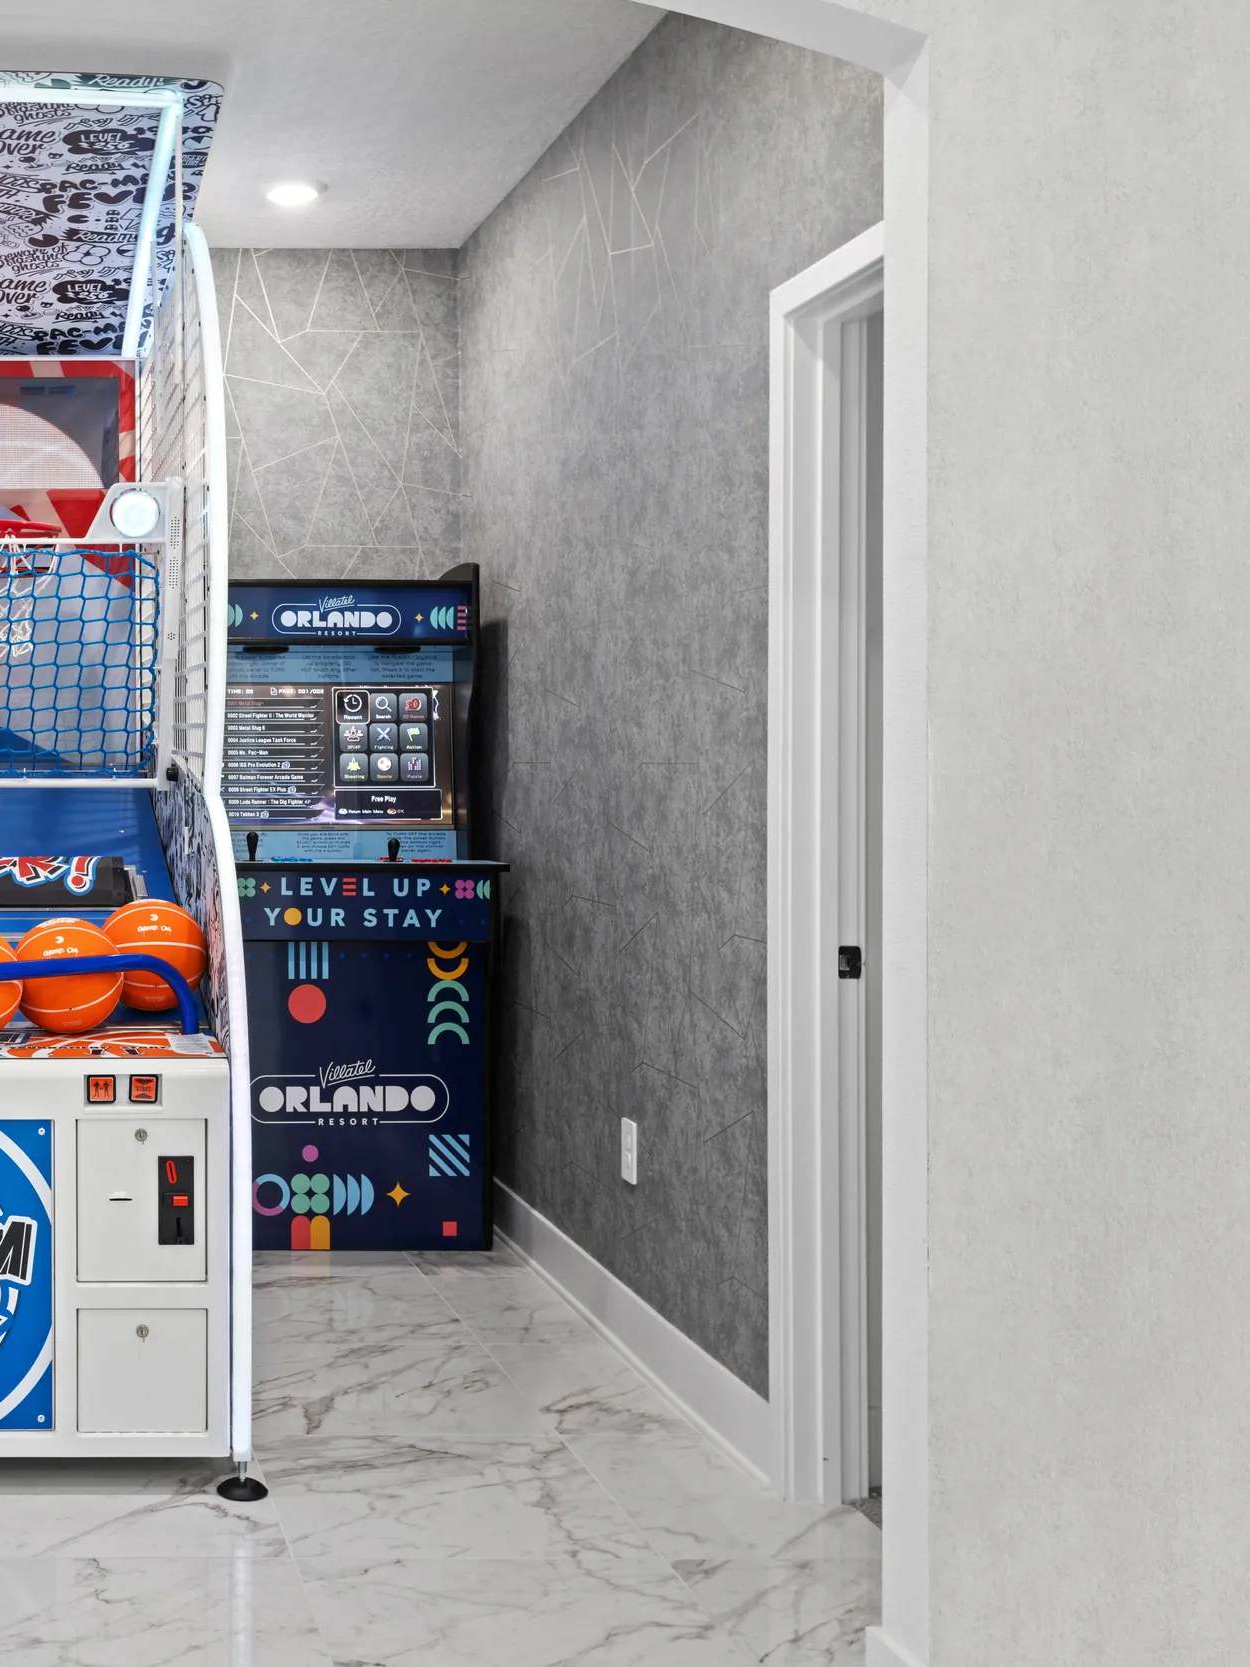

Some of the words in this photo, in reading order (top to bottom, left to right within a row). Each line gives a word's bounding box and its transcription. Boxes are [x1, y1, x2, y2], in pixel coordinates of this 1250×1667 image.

[89, 74, 165, 89] Ready!
[13, 108, 72, 124] ghosts
[80, 132, 122, 143] LEVEL
[95, 141, 138, 150] 256
[65, 162, 129, 172] Ready
[72, 231, 137, 243] Ready!
[11, 260, 60, 274] ghosts
[67, 284, 103, 293] LEVEL
[54, 311, 110, 321] Ready
[318, 594, 356, 612] Villatel
[280, 611, 393, 628] ORLANDO
[384, 795, 397, 803] Play
[280, 877, 376, 897] LEVEL
[393, 878, 432, 897] UP
[263, 907, 346, 928] YOUR
[363, 908, 443, 928] STAY
[319, 1059, 376, 1088] Villatel
[259, 1085, 436, 1113] ORLANDO
[318, 1118, 379, 1126] RESORT
